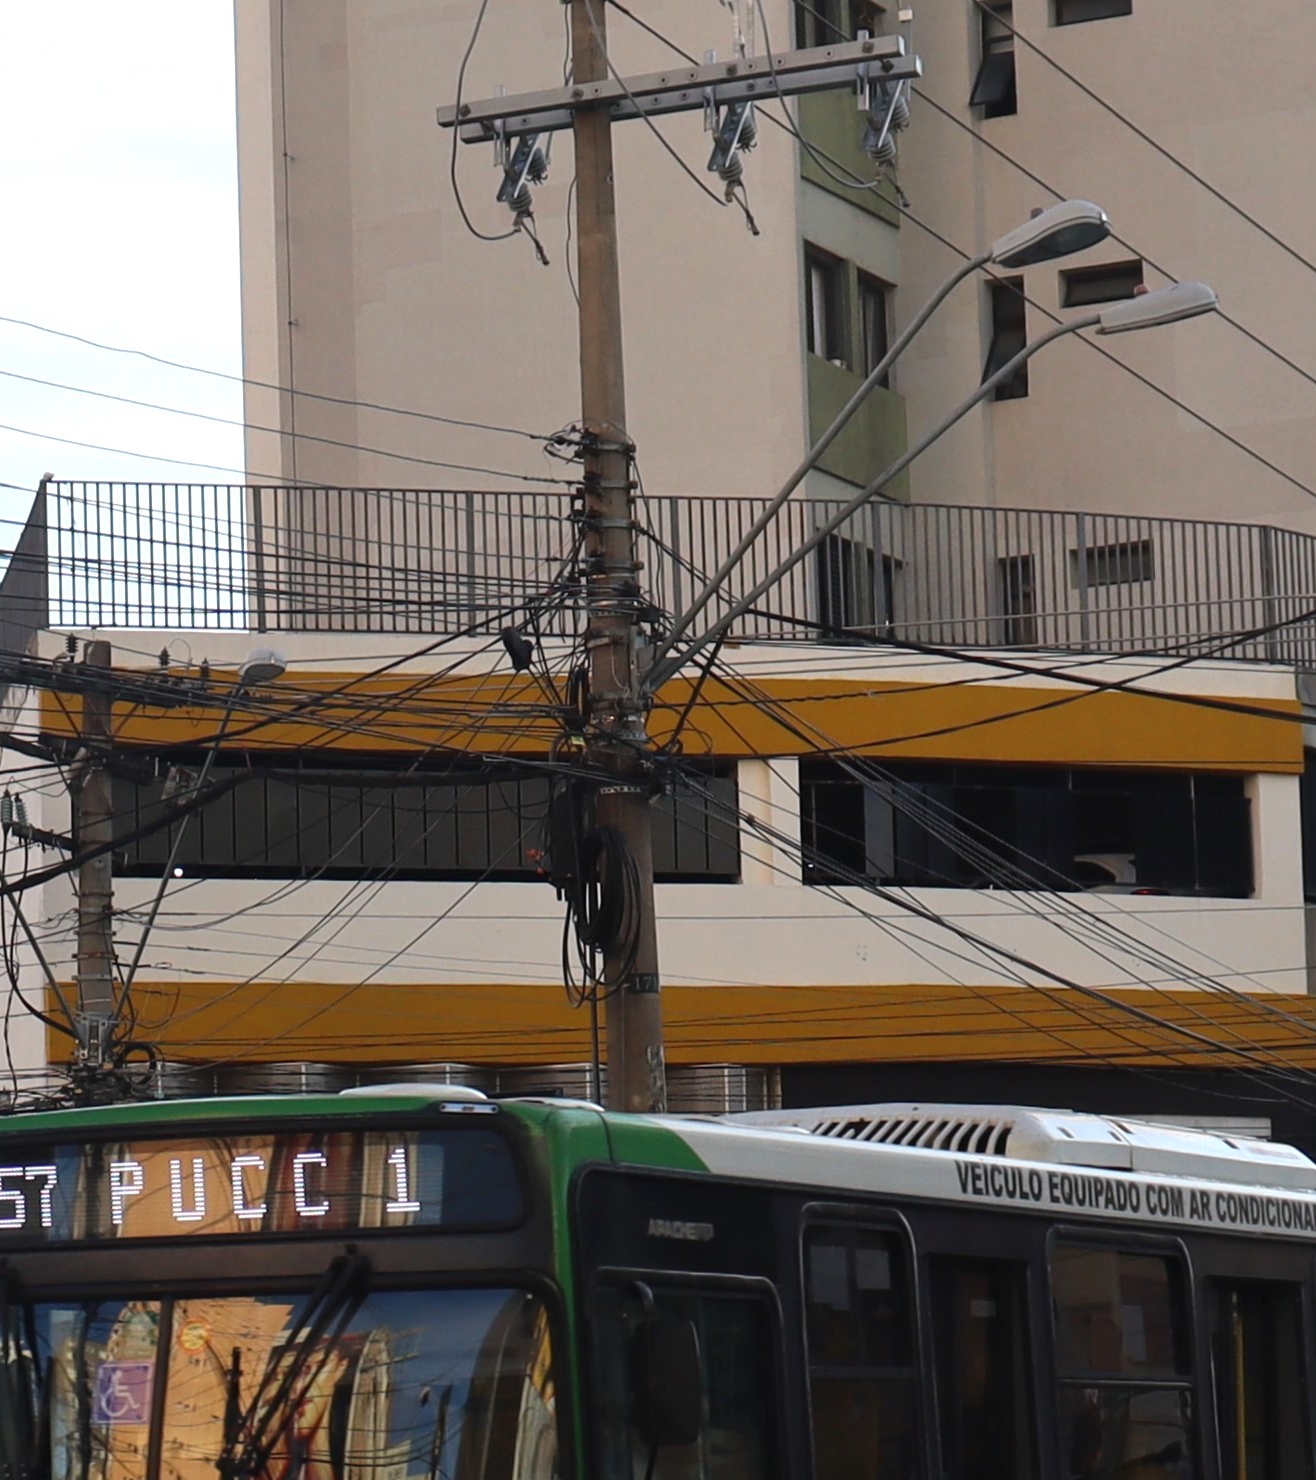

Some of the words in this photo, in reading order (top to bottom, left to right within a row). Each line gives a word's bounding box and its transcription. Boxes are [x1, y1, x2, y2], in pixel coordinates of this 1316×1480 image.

[385, 1148, 421, 1213] 1
[1049, 1171, 1140, 1213] EQUIPADO
[1146, 1184, 1184, 1217] COM
[1189, 1190, 1213, 1221] AR
